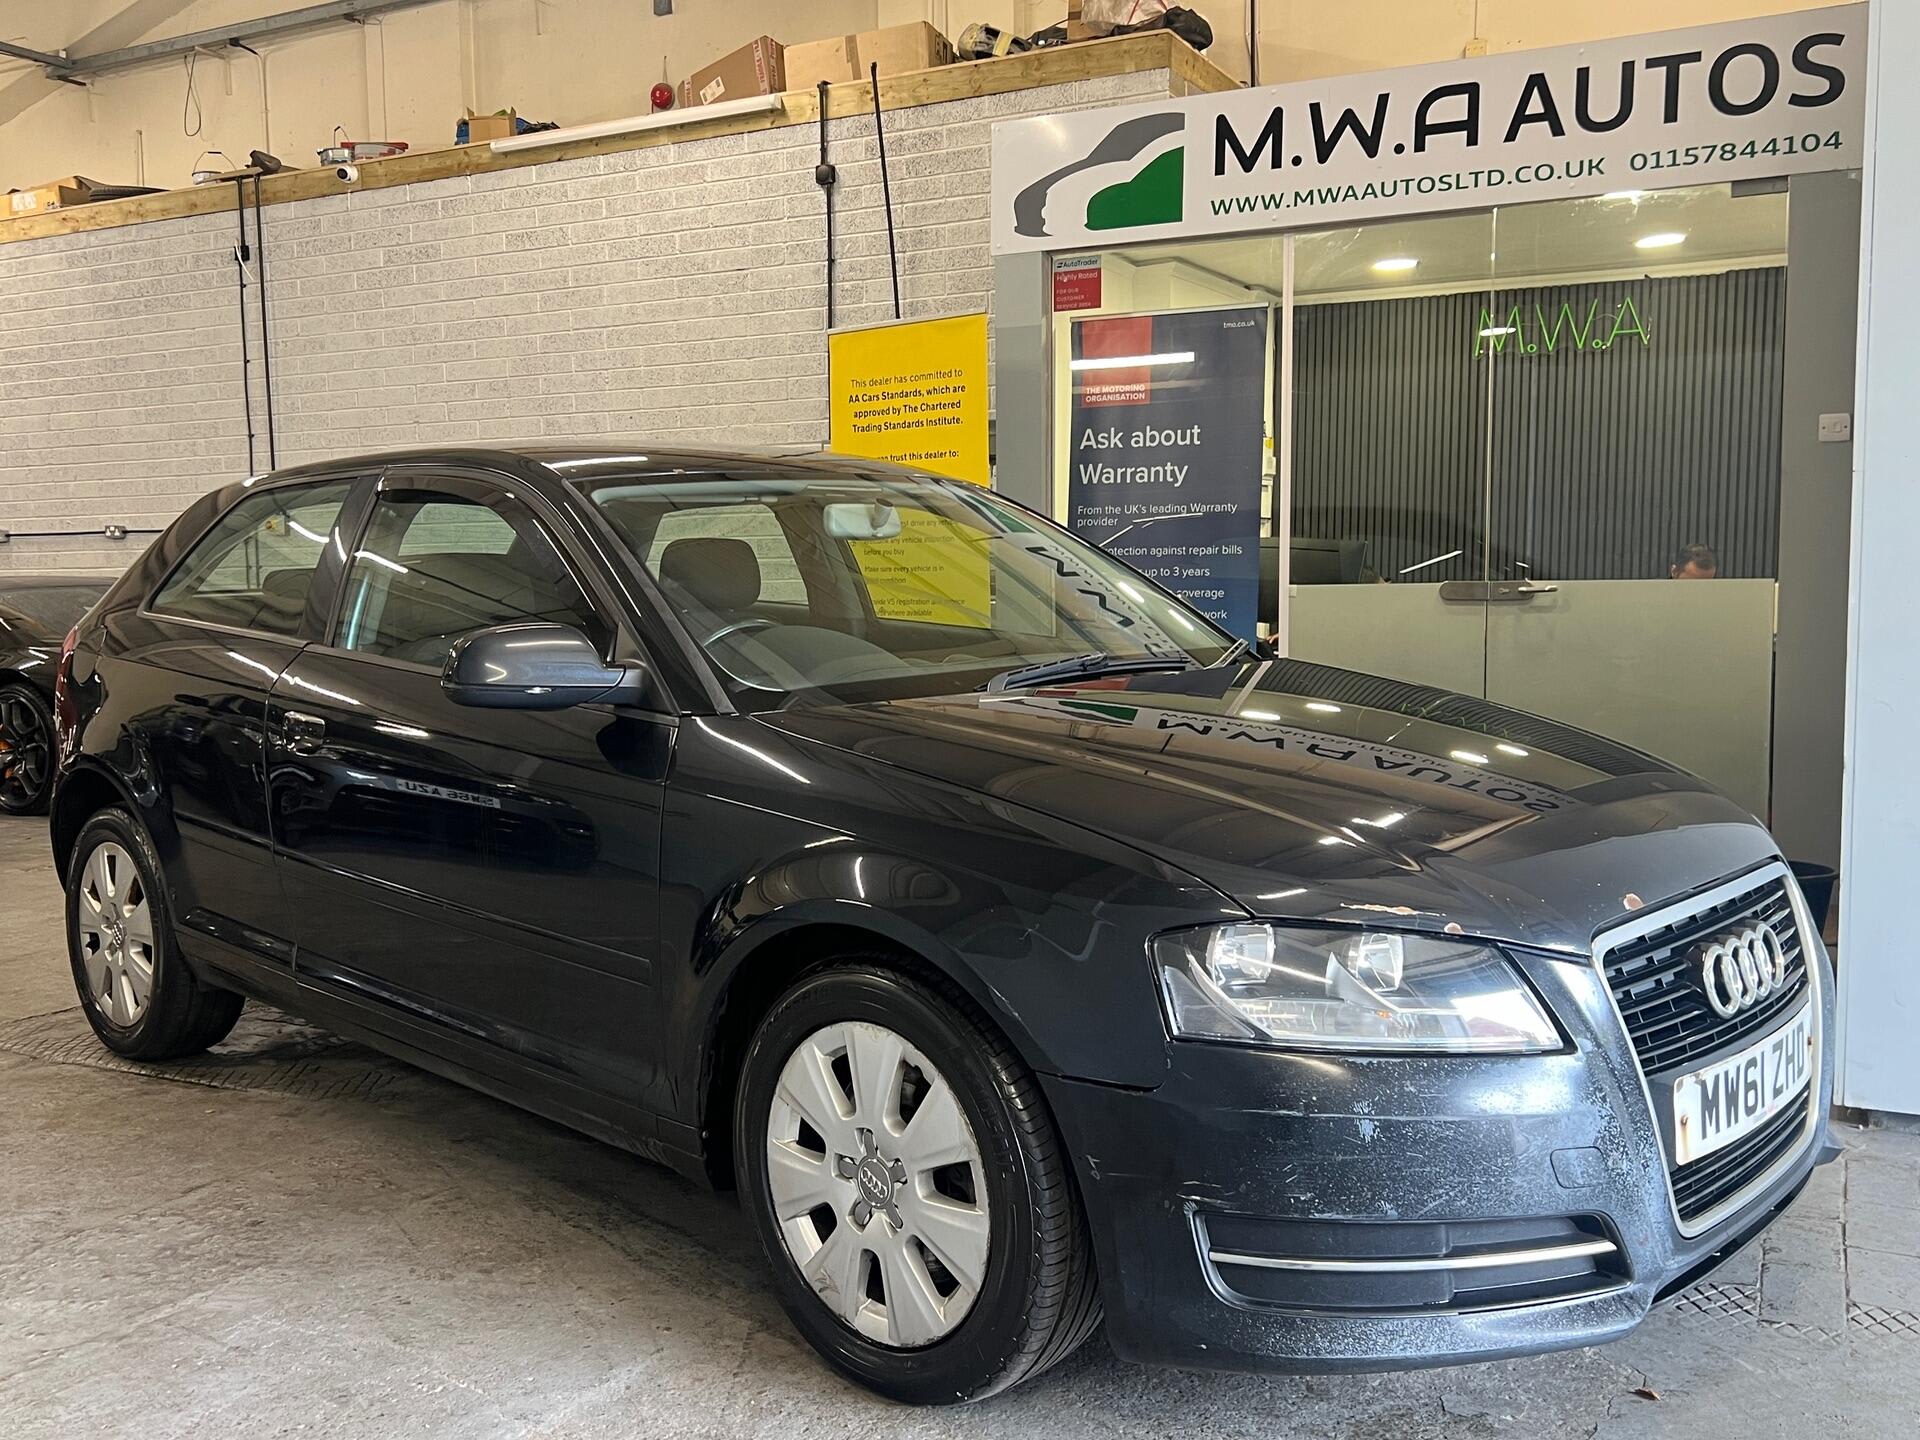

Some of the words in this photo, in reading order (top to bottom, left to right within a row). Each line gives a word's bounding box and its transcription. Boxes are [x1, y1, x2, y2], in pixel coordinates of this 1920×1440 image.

[1214, 80, 1481, 176] M.W.A
[1502, 32, 1846, 143] AUTOS
[1210, 156, 1606, 216] WWW.MWAAUTOSLTD.CO.UK
[1629, 130, 1844, 172] 01157844104
[1063, 259, 1098, 268] AutoTrader
[1078, 272, 1098, 280] Rated
[1223, 320, 1255, 329] tmo.co.uk
[1474, 296, 1649, 357] M.W.A
[851, 379, 867, 389] This
[868, 375, 893, 387] dealer
[894, 374, 908, 384] has
[909, 369, 953, 383] committed
[954, 368, 963, 378] to
[848, 394, 860, 405] AA
[861, 393, 880, 403] Cars
[881, 388, 925, 401] Standards,
[926, 384, 951, 396] which
[952, 384, 966, 393] are
[1085, 386, 1101, 394] THE
[1101, 383, 1145, 393] MOTORING
[1085, 392, 1146, 403] ORGANISATION
[853, 406, 891, 420] approved
[892, 405, 901, 416] by
[903, 403, 919, 414] The
[920, 399, 961, 412] Chartered
[852, 422, 882, 433] Trading
[883, 418, 925, 431] Standards
[925, 415, 964, 428] Institute.
[1079, 427, 1124, 450] Ask
[1130, 424, 1201, 448] about
[890, 453, 907, 462] trust
[909, 451, 923, 461] this
[924, 450, 948, 460] dealer
[949, 449, 960, 458] to:
[1079, 461, 1189, 488] Warranty
[1077, 505, 1103, 515] From
[1104, 505, 1121, 515] the
[1124, 504, 1147, 515] UK's
[1149, 503, 1187, 516] leading
[1189, 503, 1238, 514] Warranty
[1077, 516, 1118, 528] provider
[1149, 546, 1186, 558] against
[1188, 545, 1219, 557] repair
[1221, 545, 1243, 555] bills
[1146, 569, 1158, 578] up
[1160, 568, 1171, 577] to
[1172, 567, 1180, 577] 3
[1182, 568, 1211, 579] years
[1700, 1051, 1765, 1141] MW61
[1772, 1021, 1805, 1101] ZHD
